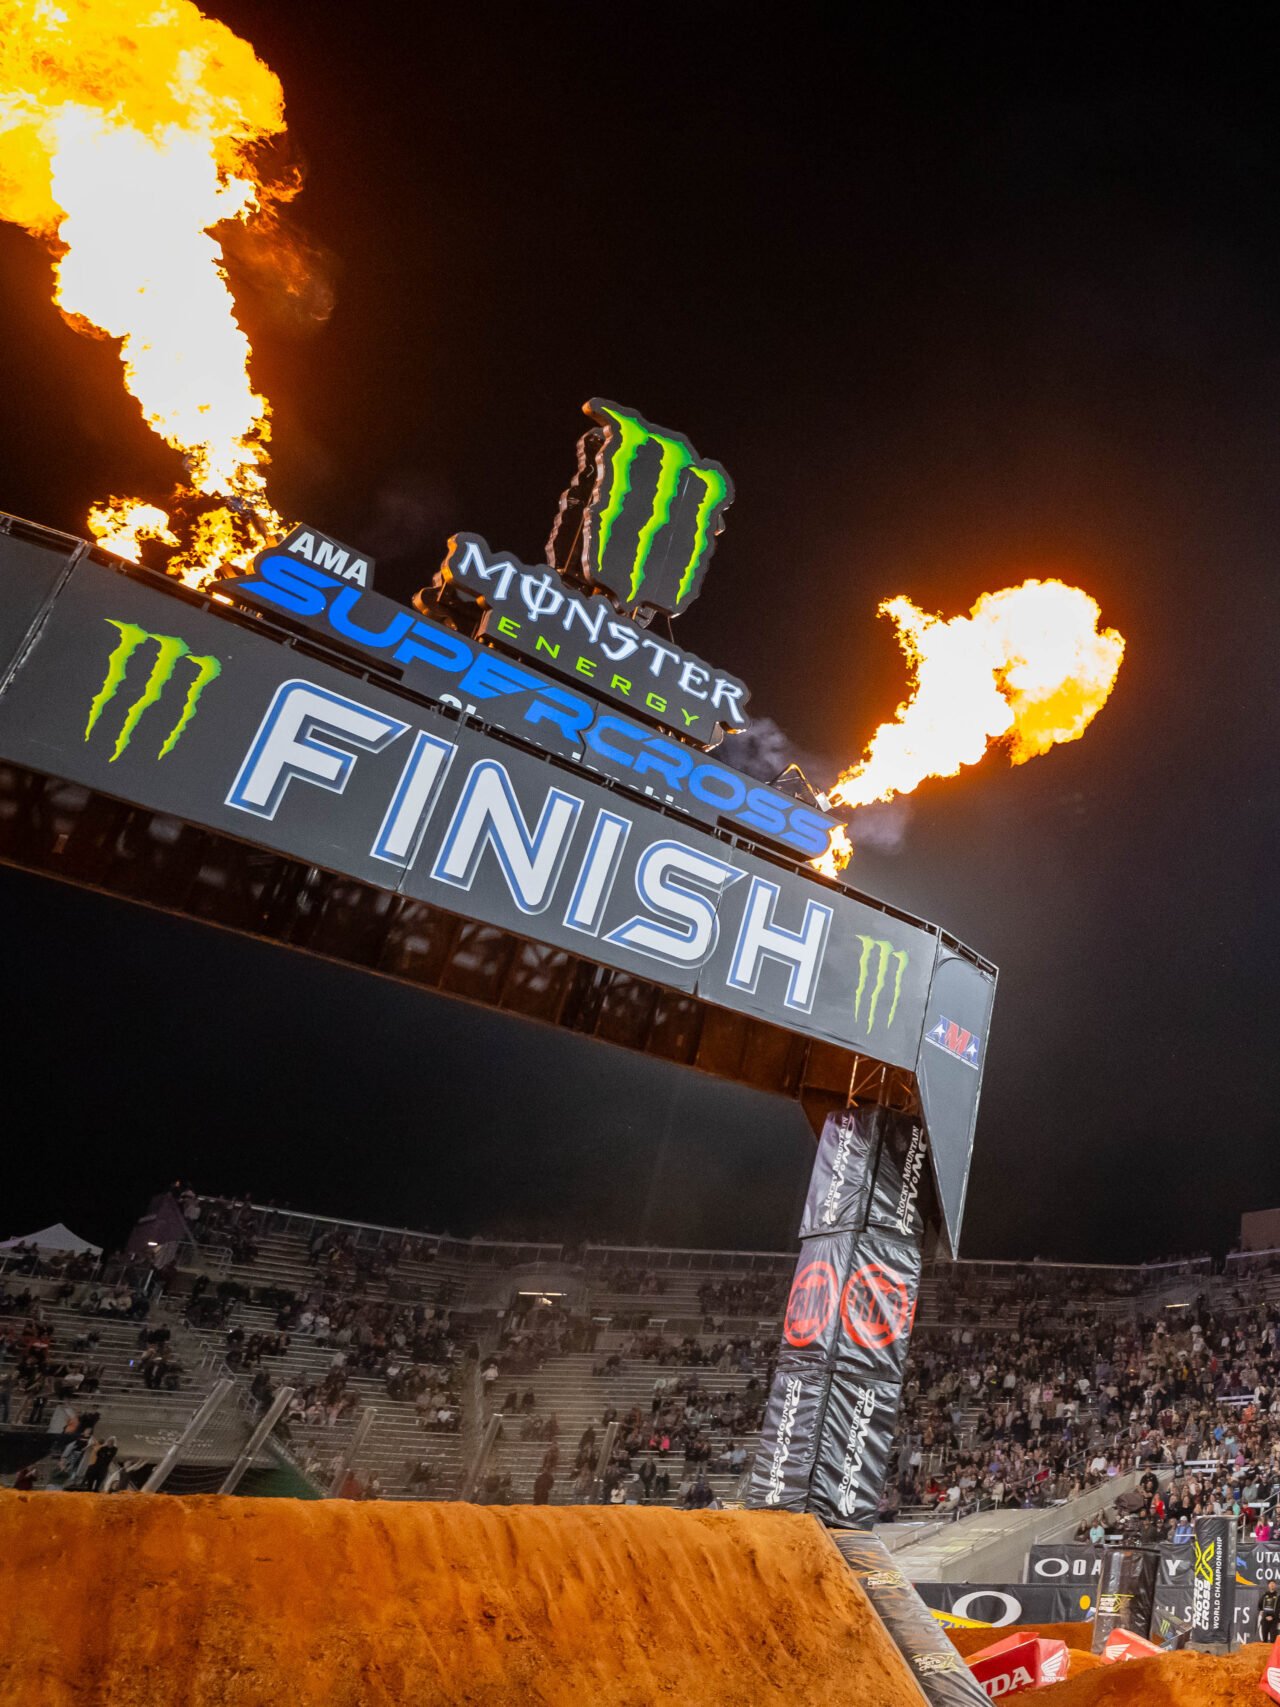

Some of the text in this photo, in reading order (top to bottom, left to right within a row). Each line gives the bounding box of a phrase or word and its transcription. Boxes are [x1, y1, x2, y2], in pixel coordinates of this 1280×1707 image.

[288, 531, 370, 587] AMA
[458, 541, 746, 724] MONSTER
[497, 616, 700, 727] ENERGY
[238, 554, 838, 856] SUPERCROSS
[224, 678, 834, 1015] FINISH
[896, 1125, 921, 1217] ROCKY MOUNTAIN
[776, 1379, 795, 1446] MOUNTAIN
[1212, 1536, 1223, 1630] WORLD CHAMPIONSHIP
